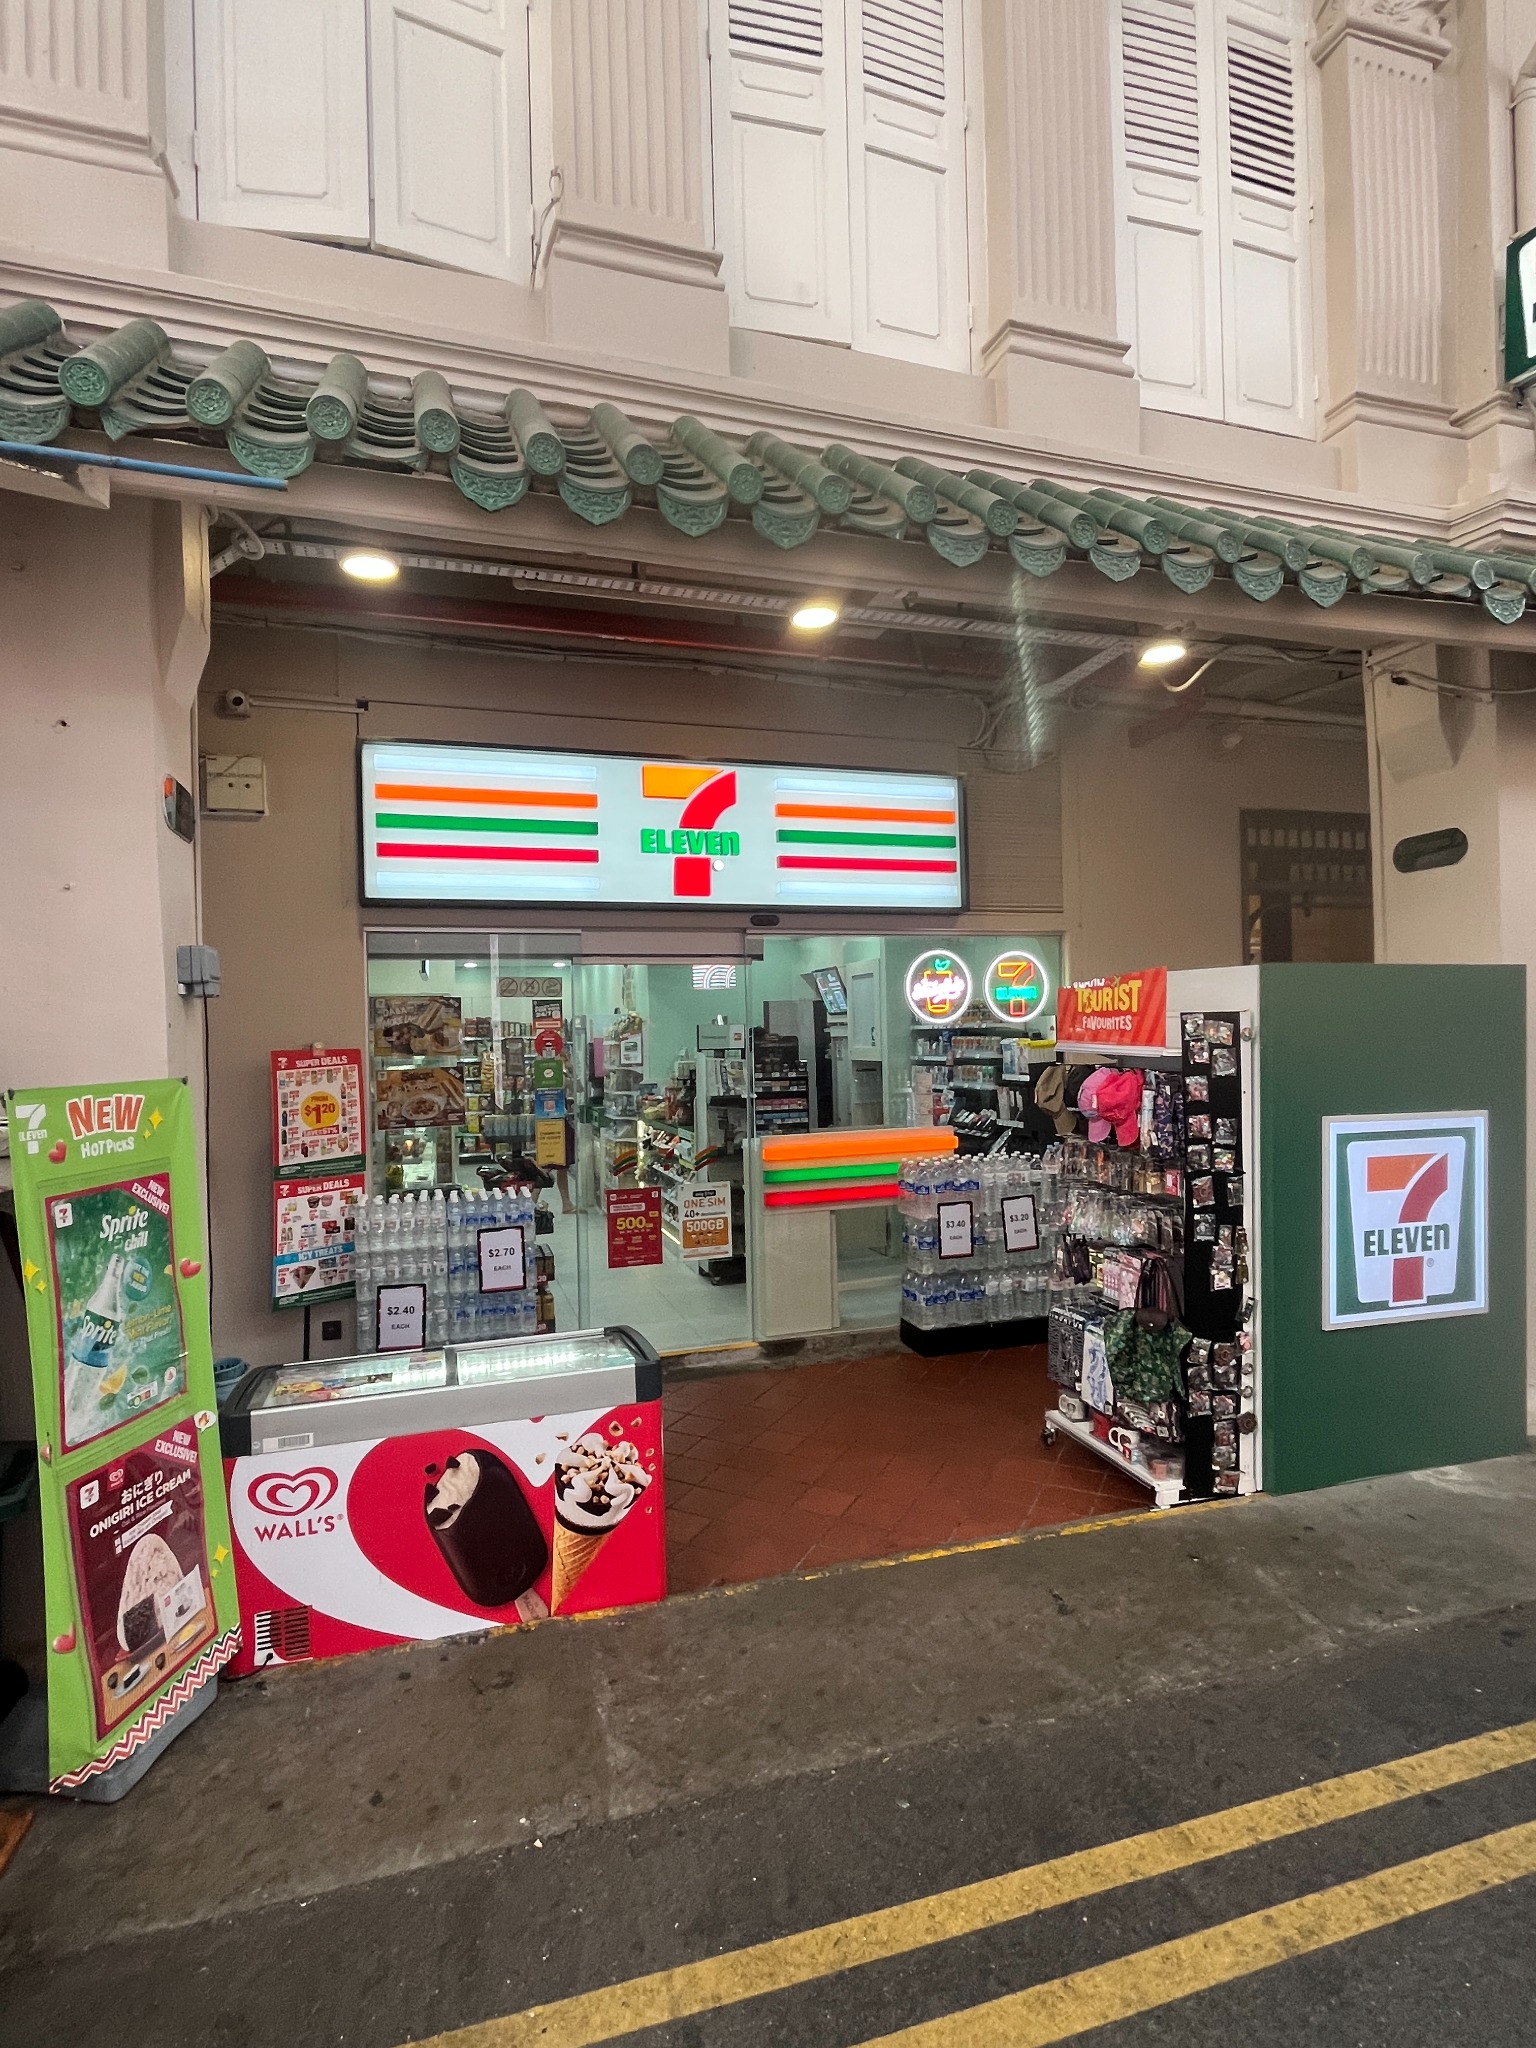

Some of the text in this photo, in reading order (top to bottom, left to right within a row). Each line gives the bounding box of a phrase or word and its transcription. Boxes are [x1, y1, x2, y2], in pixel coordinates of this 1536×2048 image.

[641, 764, 737, 897] 7
[1075, 979, 1142, 1013] TOURIST
[295, 1055, 348, 1067] SUPER DEALS
[66, 1094, 145, 1140] NEW
[148, 1179, 165, 1197] NEW
[297, 1179, 350, 1195] SUPER DEALS
[131, 1182, 170, 1215] EXCLUSIVE!
[683, 1197, 726, 1209] ONE SIM
[684, 1210, 700, 1218] 40+
[1009, 1213, 1030, 1222] $3.20
[100, 1206, 149, 1241] Sprite
[616, 1216, 646, 1231] 500
[686, 1219, 724, 1233] 500GB
[946, 1220, 966, 1229] $3.40
[1366, 1152, 1449, 1303] 7
[297, 1245, 343, 1262] ICY TREATS
[488, 1247, 515, 1258] $2.70
[387, 1305, 415, 1316] $2.40
[81, 1315, 117, 1345] Sprite
[172, 1430, 191, 1446] NEW
[154, 1439, 198, 1463] EXCLUSIVE!
[121, 1470, 164, 1505] おにぎり
[89, 1503, 134, 1538] ONIGIRI
[135, 1491, 154, 1511] ICE
[155, 1468, 192, 1498] CREAM
[254, 1515, 335, 1543] WALL'S
